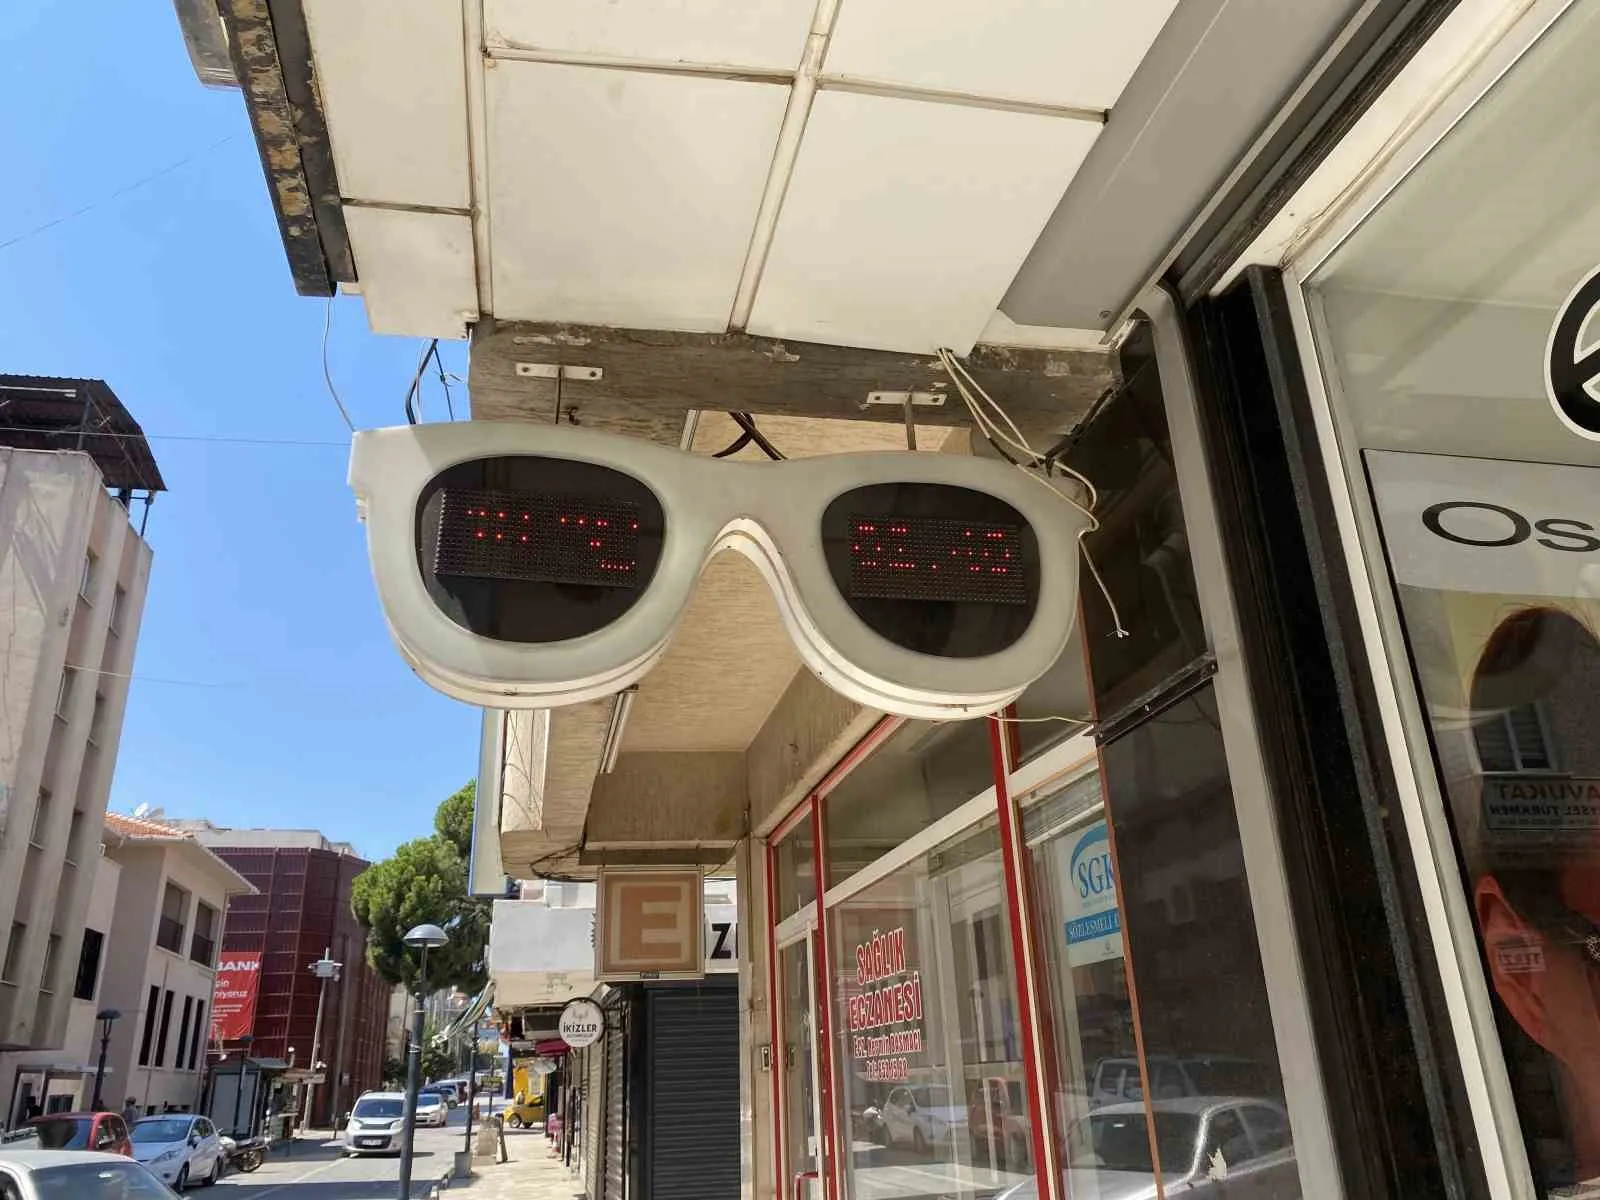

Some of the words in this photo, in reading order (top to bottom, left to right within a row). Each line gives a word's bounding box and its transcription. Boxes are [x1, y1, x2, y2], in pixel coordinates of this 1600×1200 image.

[620, 886, 682, 960] E
[856, 927, 906, 986] SAĞLIK
[563, 1021, 597, 1033] İKİZLER
[849, 970, 922, 1032] ECZANESİ
